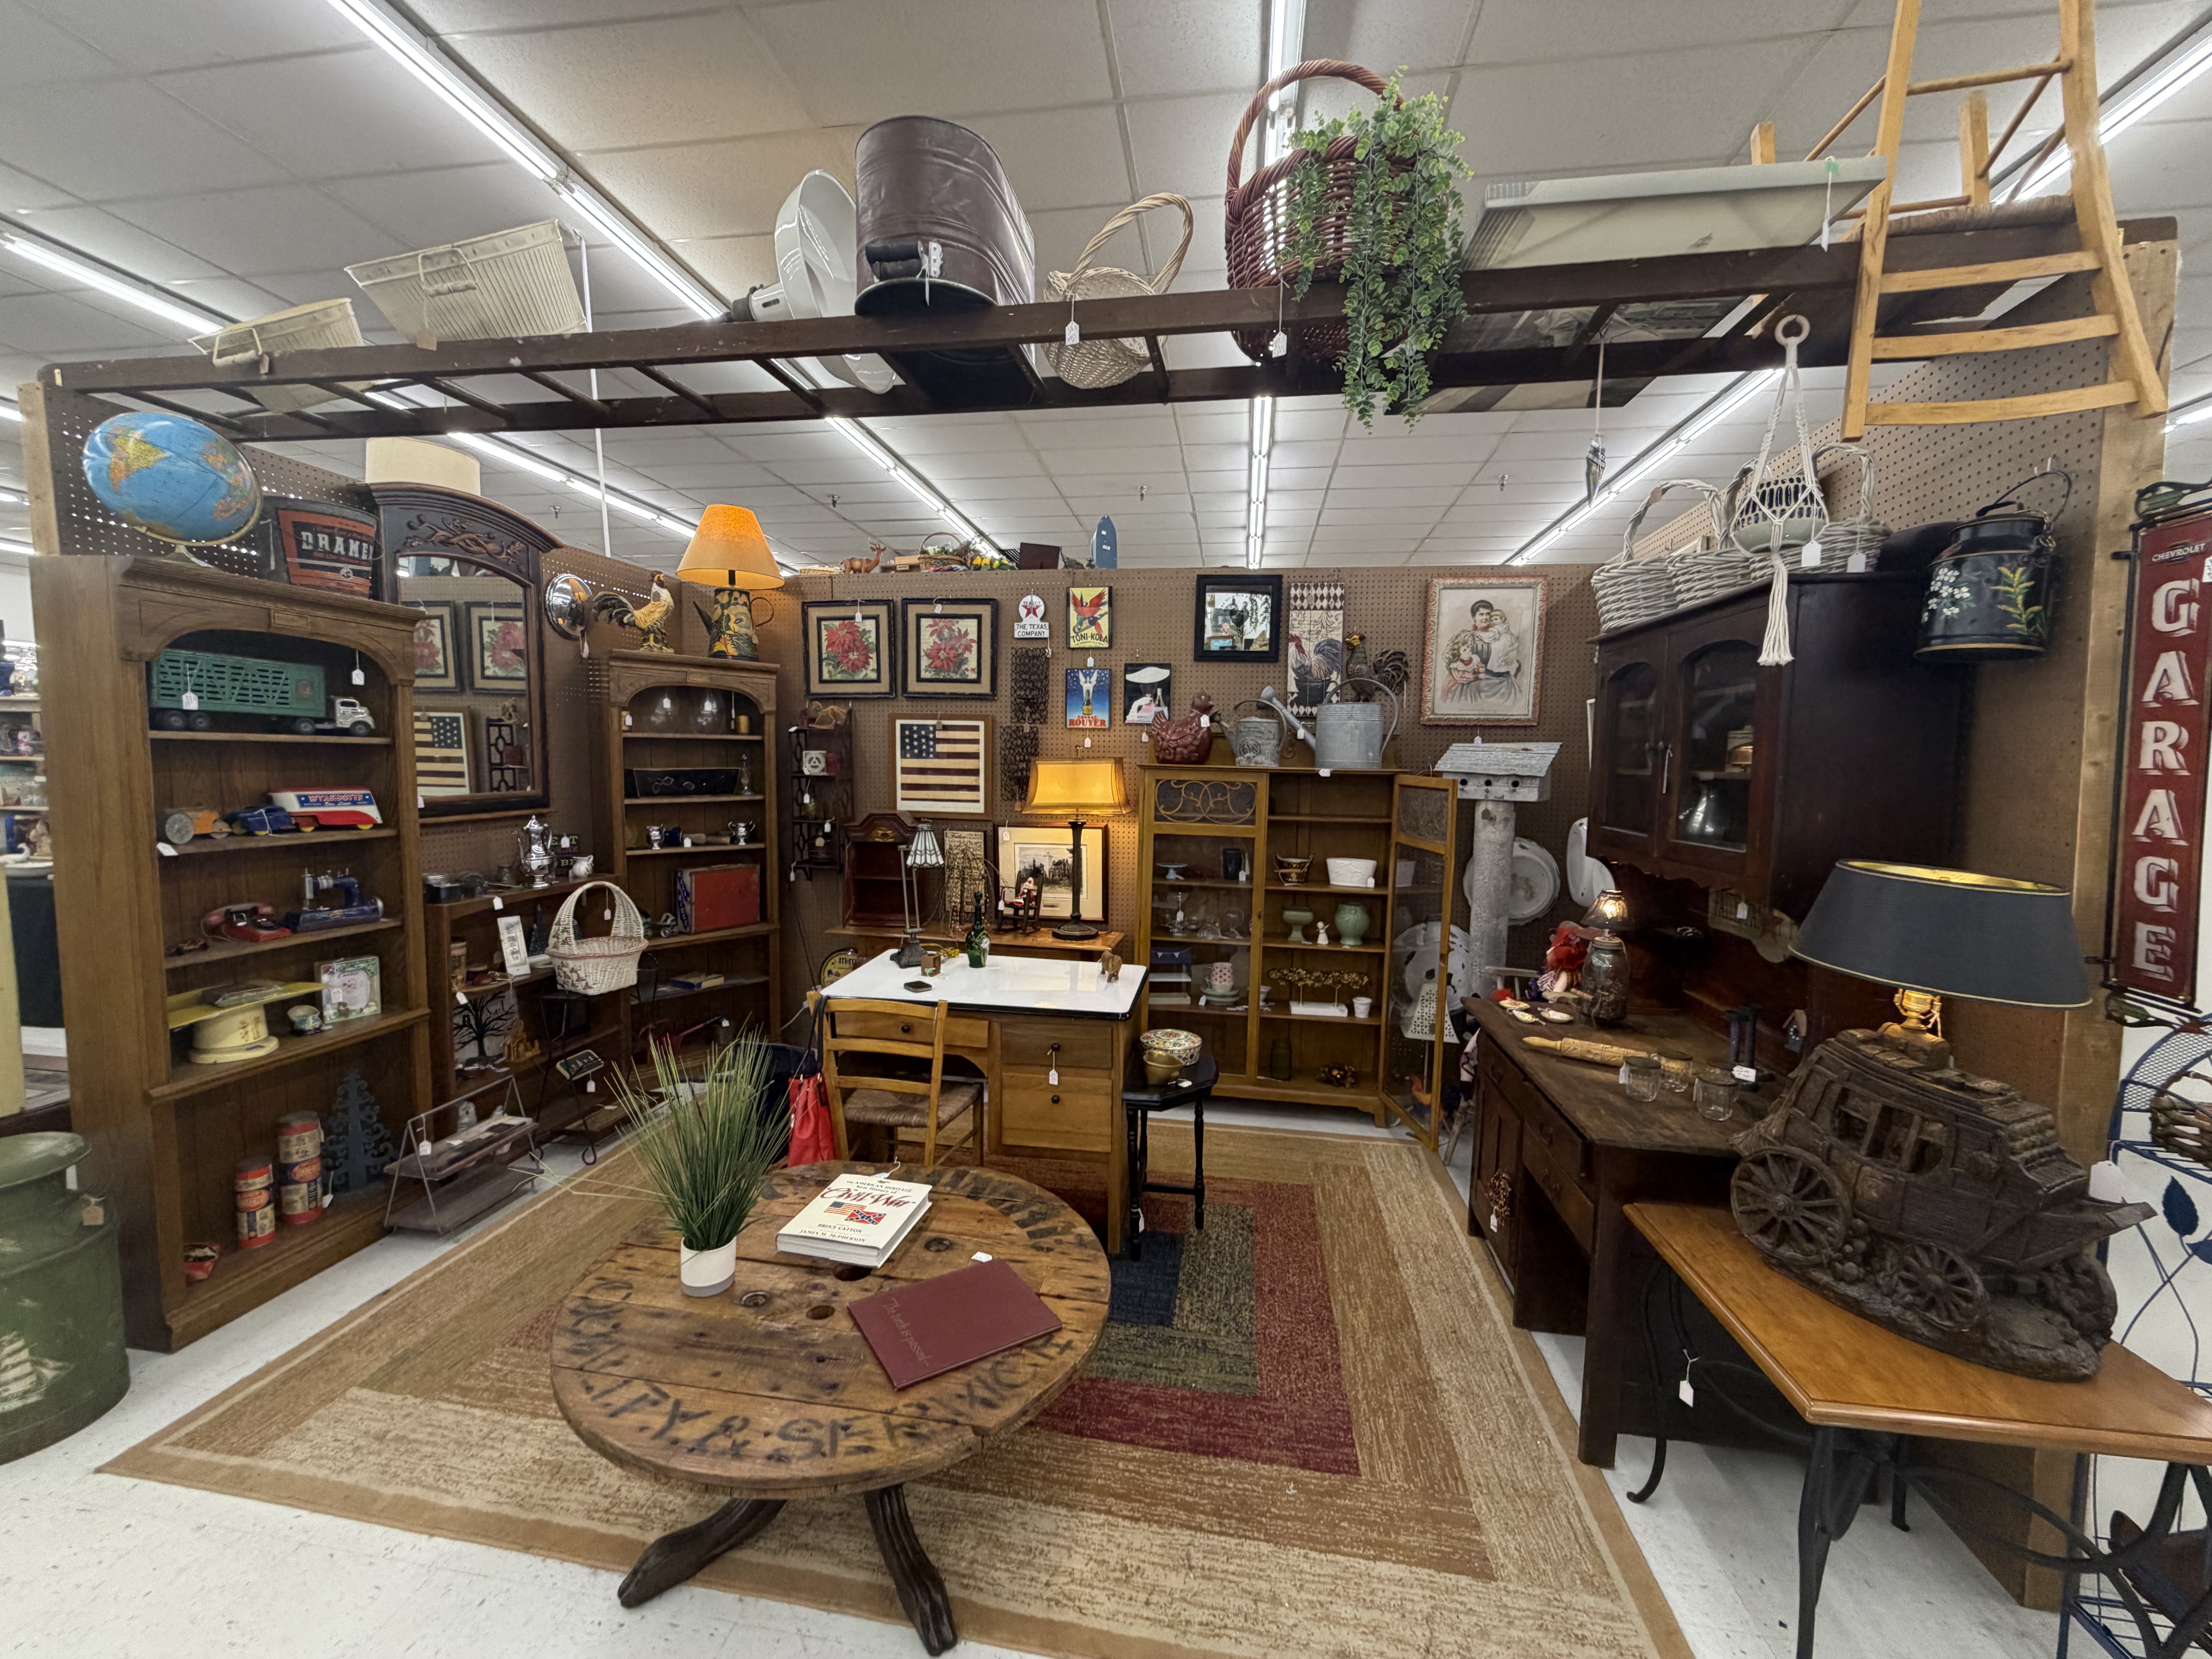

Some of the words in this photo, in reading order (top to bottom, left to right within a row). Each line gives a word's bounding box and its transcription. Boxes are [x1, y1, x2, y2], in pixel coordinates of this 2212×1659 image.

[2152, 543, 2206, 562] CHEVROLET
[1070, 632, 1108, 643] TONI-KOLA
[2131, 578, 2200, 983] GARAGE
[550, 836, 578, 845] ET
